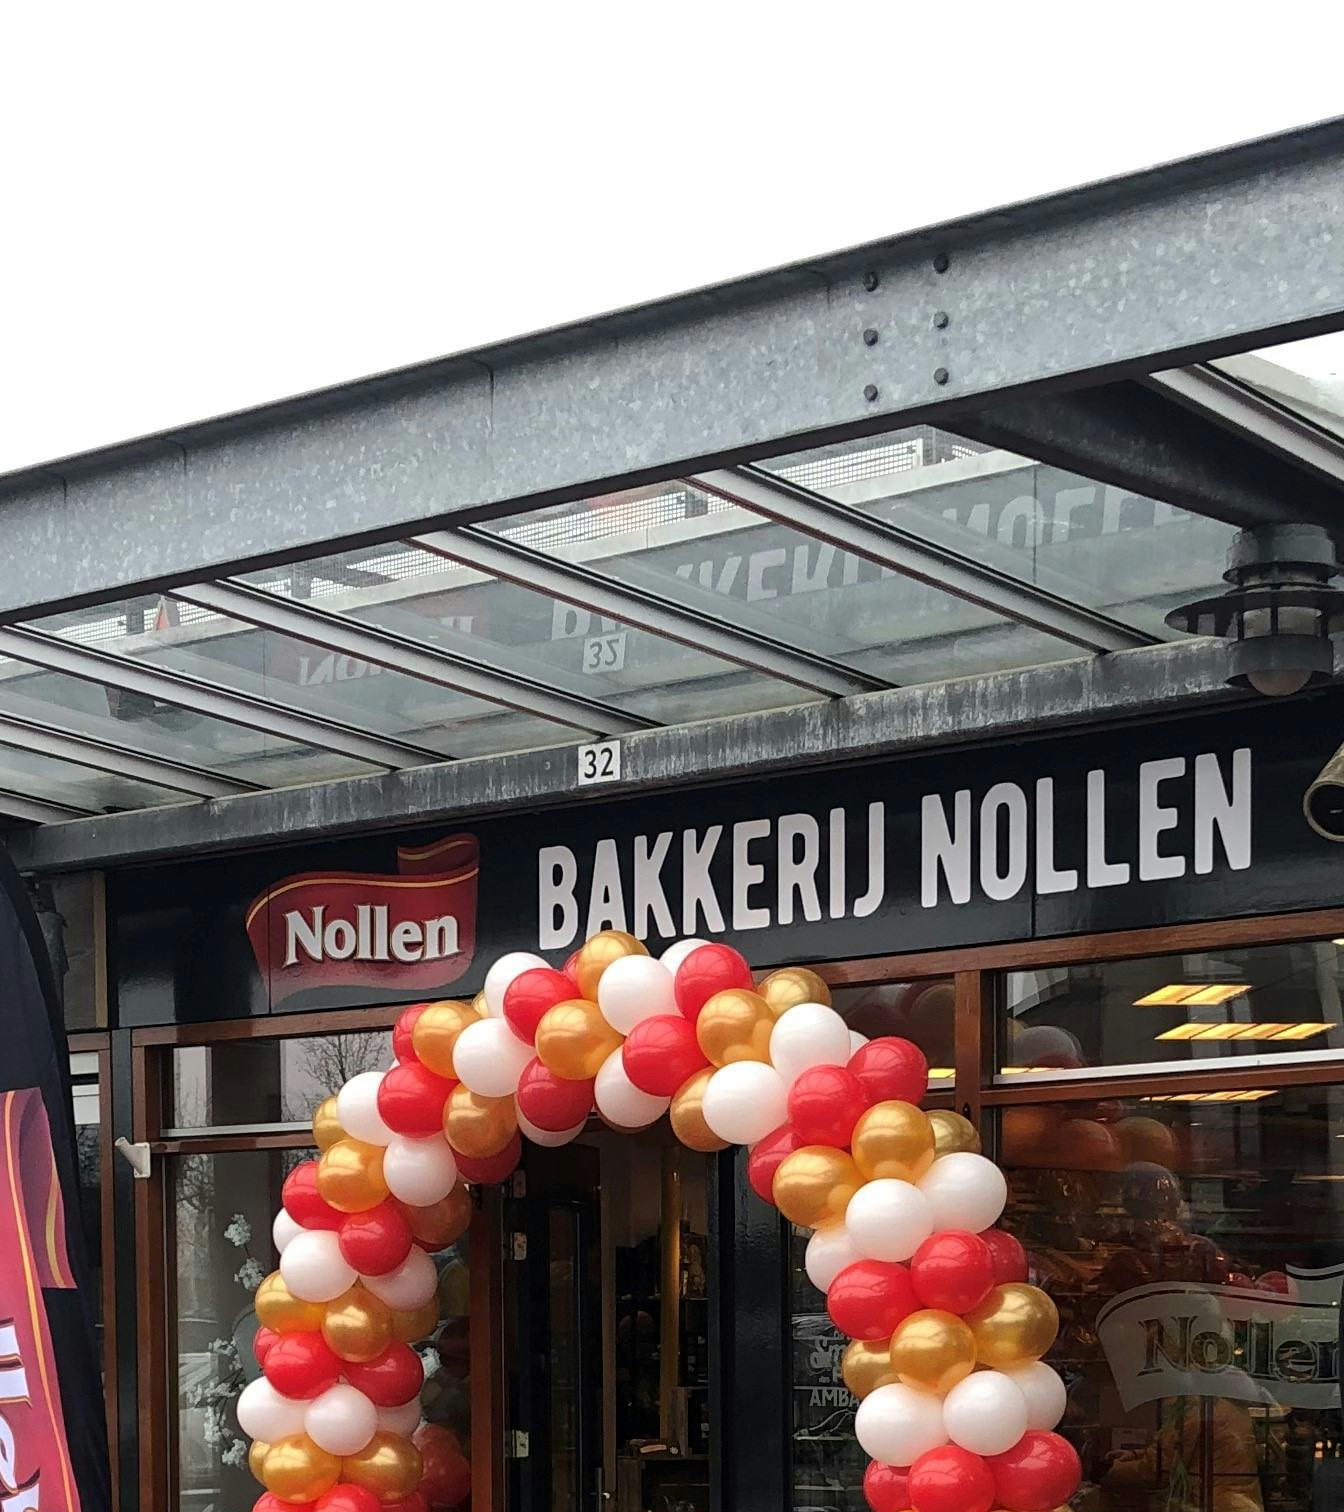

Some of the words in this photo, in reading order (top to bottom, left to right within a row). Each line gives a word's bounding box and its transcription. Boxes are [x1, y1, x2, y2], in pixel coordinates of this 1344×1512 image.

[583, 746, 614, 779] 32
[538, 801, 885, 951] BAKKERIJ
[921, 747, 1253, 909] NOLLEN
[281, 903, 463, 967] Nollen
